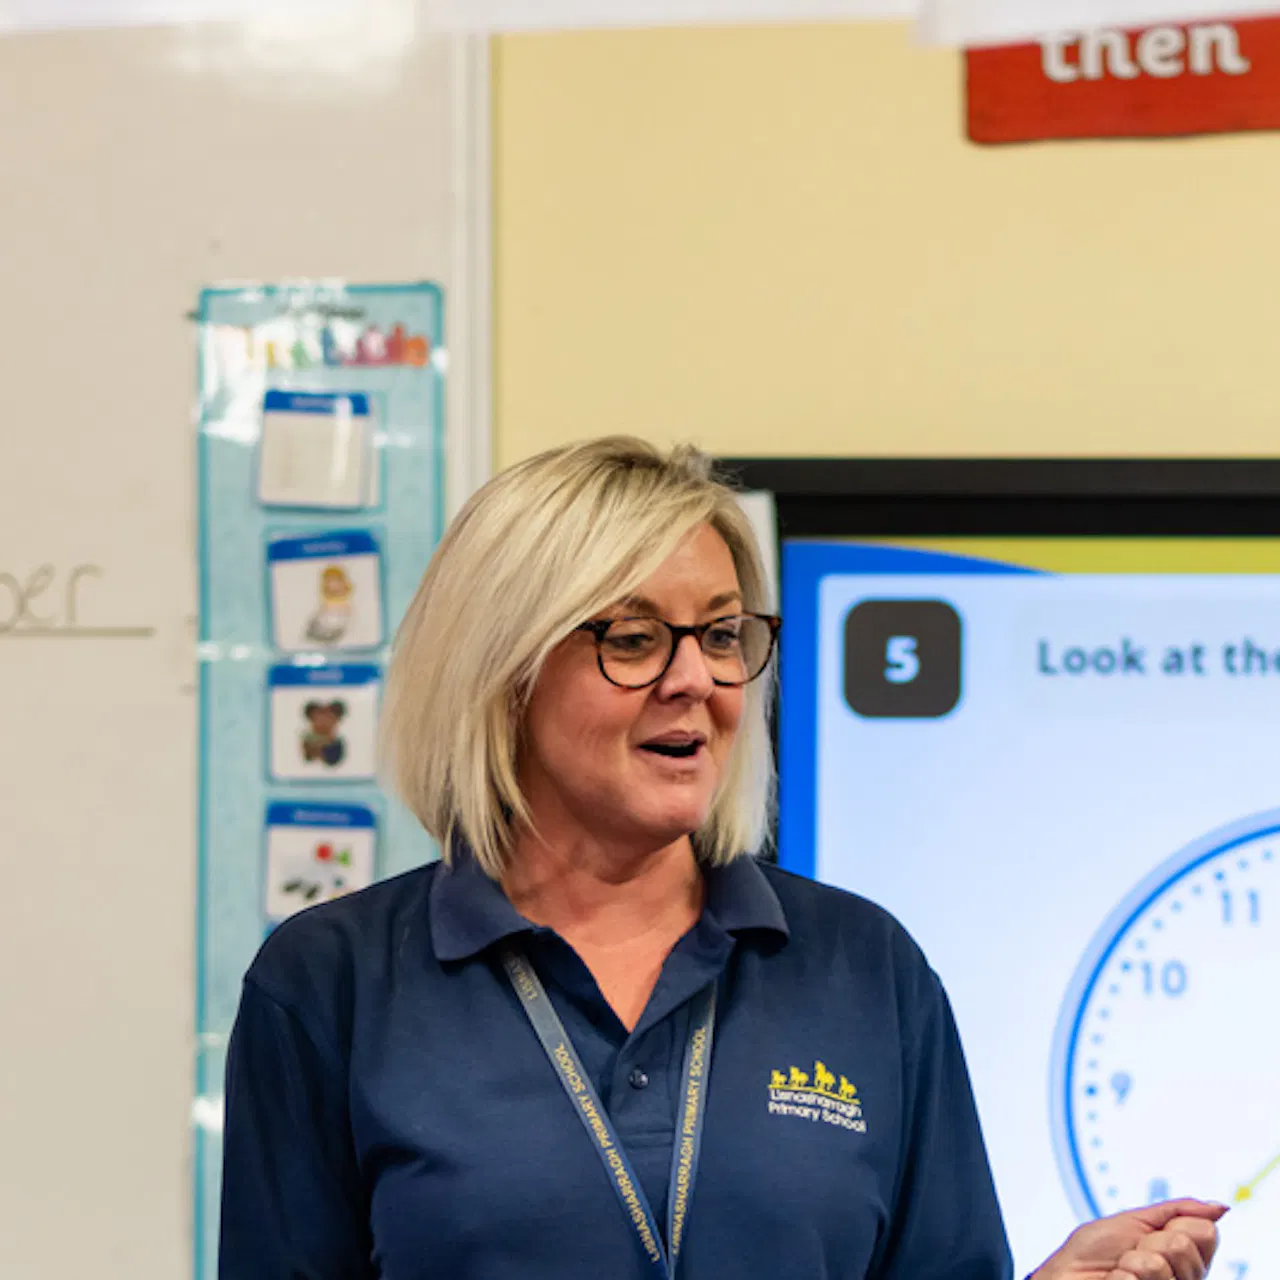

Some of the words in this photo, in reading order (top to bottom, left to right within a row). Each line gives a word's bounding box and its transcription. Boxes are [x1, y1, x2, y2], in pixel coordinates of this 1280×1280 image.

[1040, 24, 1251, 82] then
[884, 635, 920, 683] 5
[1037, 637, 1146, 677] Look
[1161, 643, 1205, 676] at
[1219, 888, 1261, 926] 11
[1139, 959, 1188, 998] 10
[555, 1042, 587, 1096] SCHOOL
[688, 1027, 707, 1080] SCHOOL
[682, 1079, 702, 1138] PRIMARY
[1109, 1070, 1134, 1105] 9
[579, 1093, 613, 1149] PRIMARY
[767, 1100, 821, 1123] Primary
[821, 1108, 868, 1135] School
